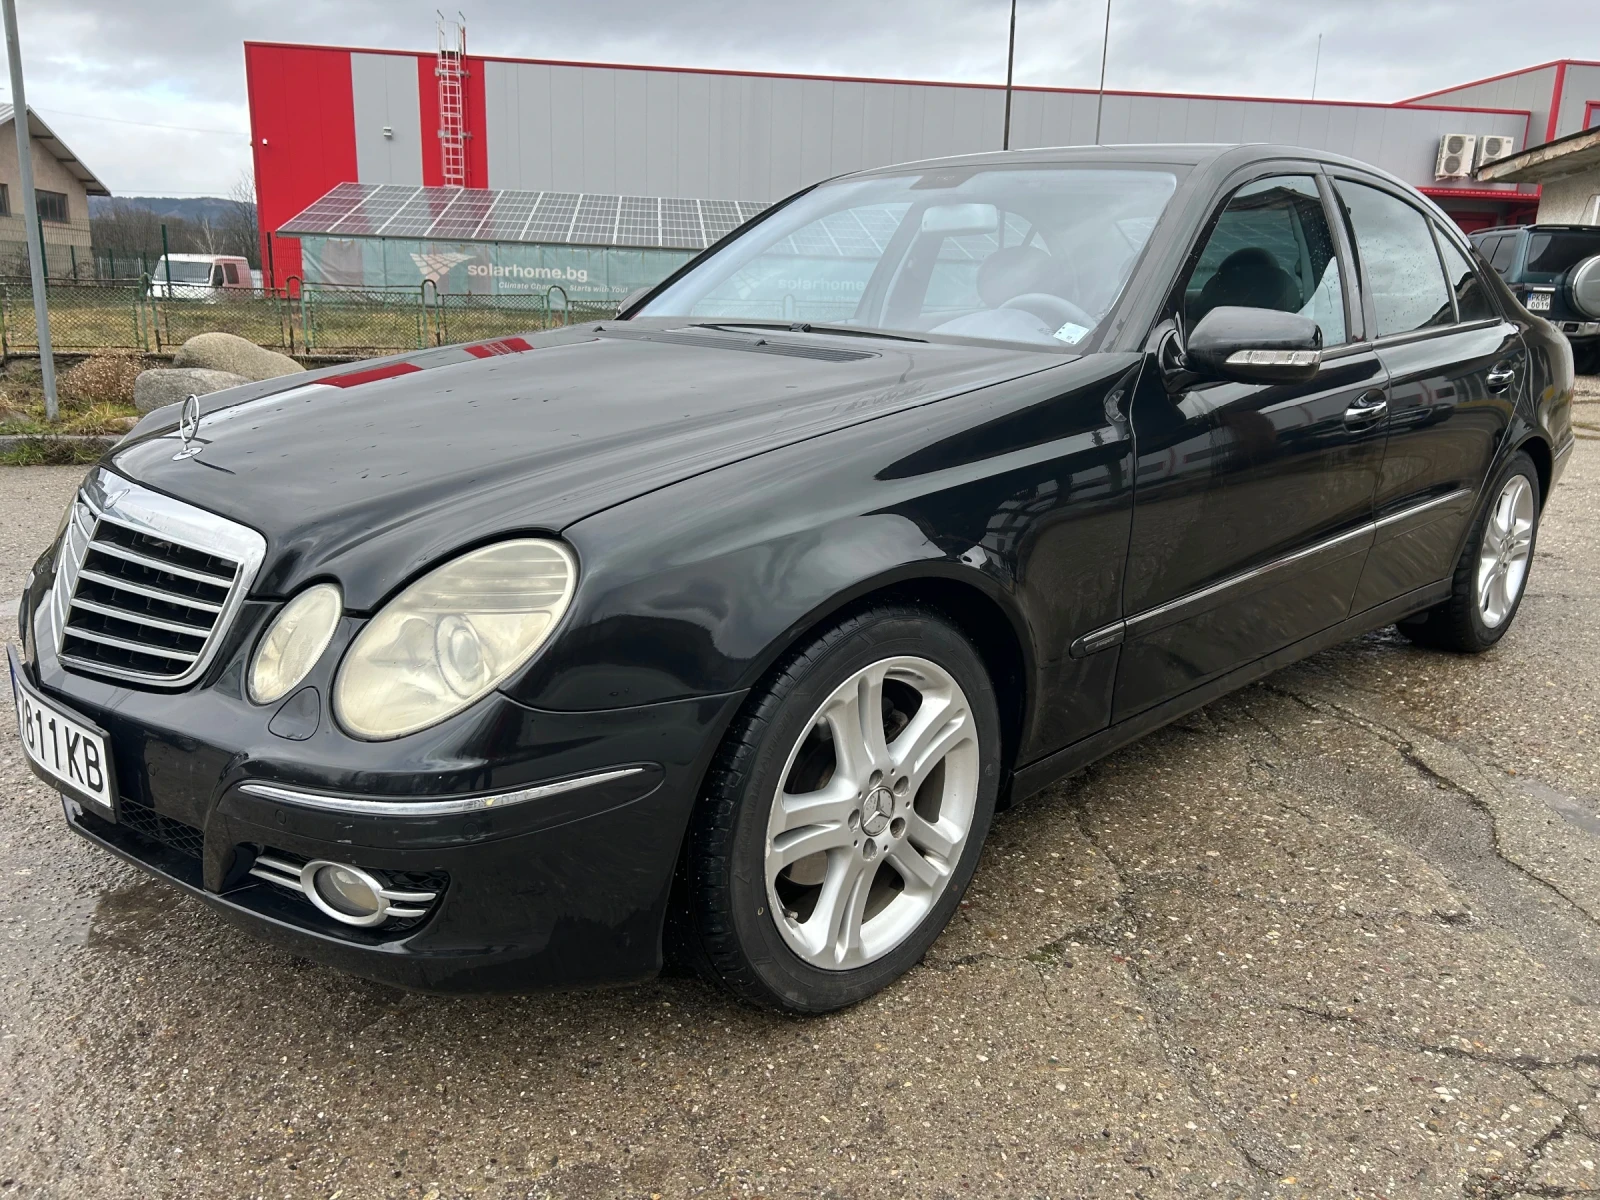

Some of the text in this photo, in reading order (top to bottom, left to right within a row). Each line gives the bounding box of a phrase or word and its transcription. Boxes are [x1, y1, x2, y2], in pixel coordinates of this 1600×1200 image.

[467, 263, 588, 283] solarhome.bg
[498, 281, 529, 290] Climate
[569, 284, 591, 292] Starts
[593, 285, 609, 293] with
